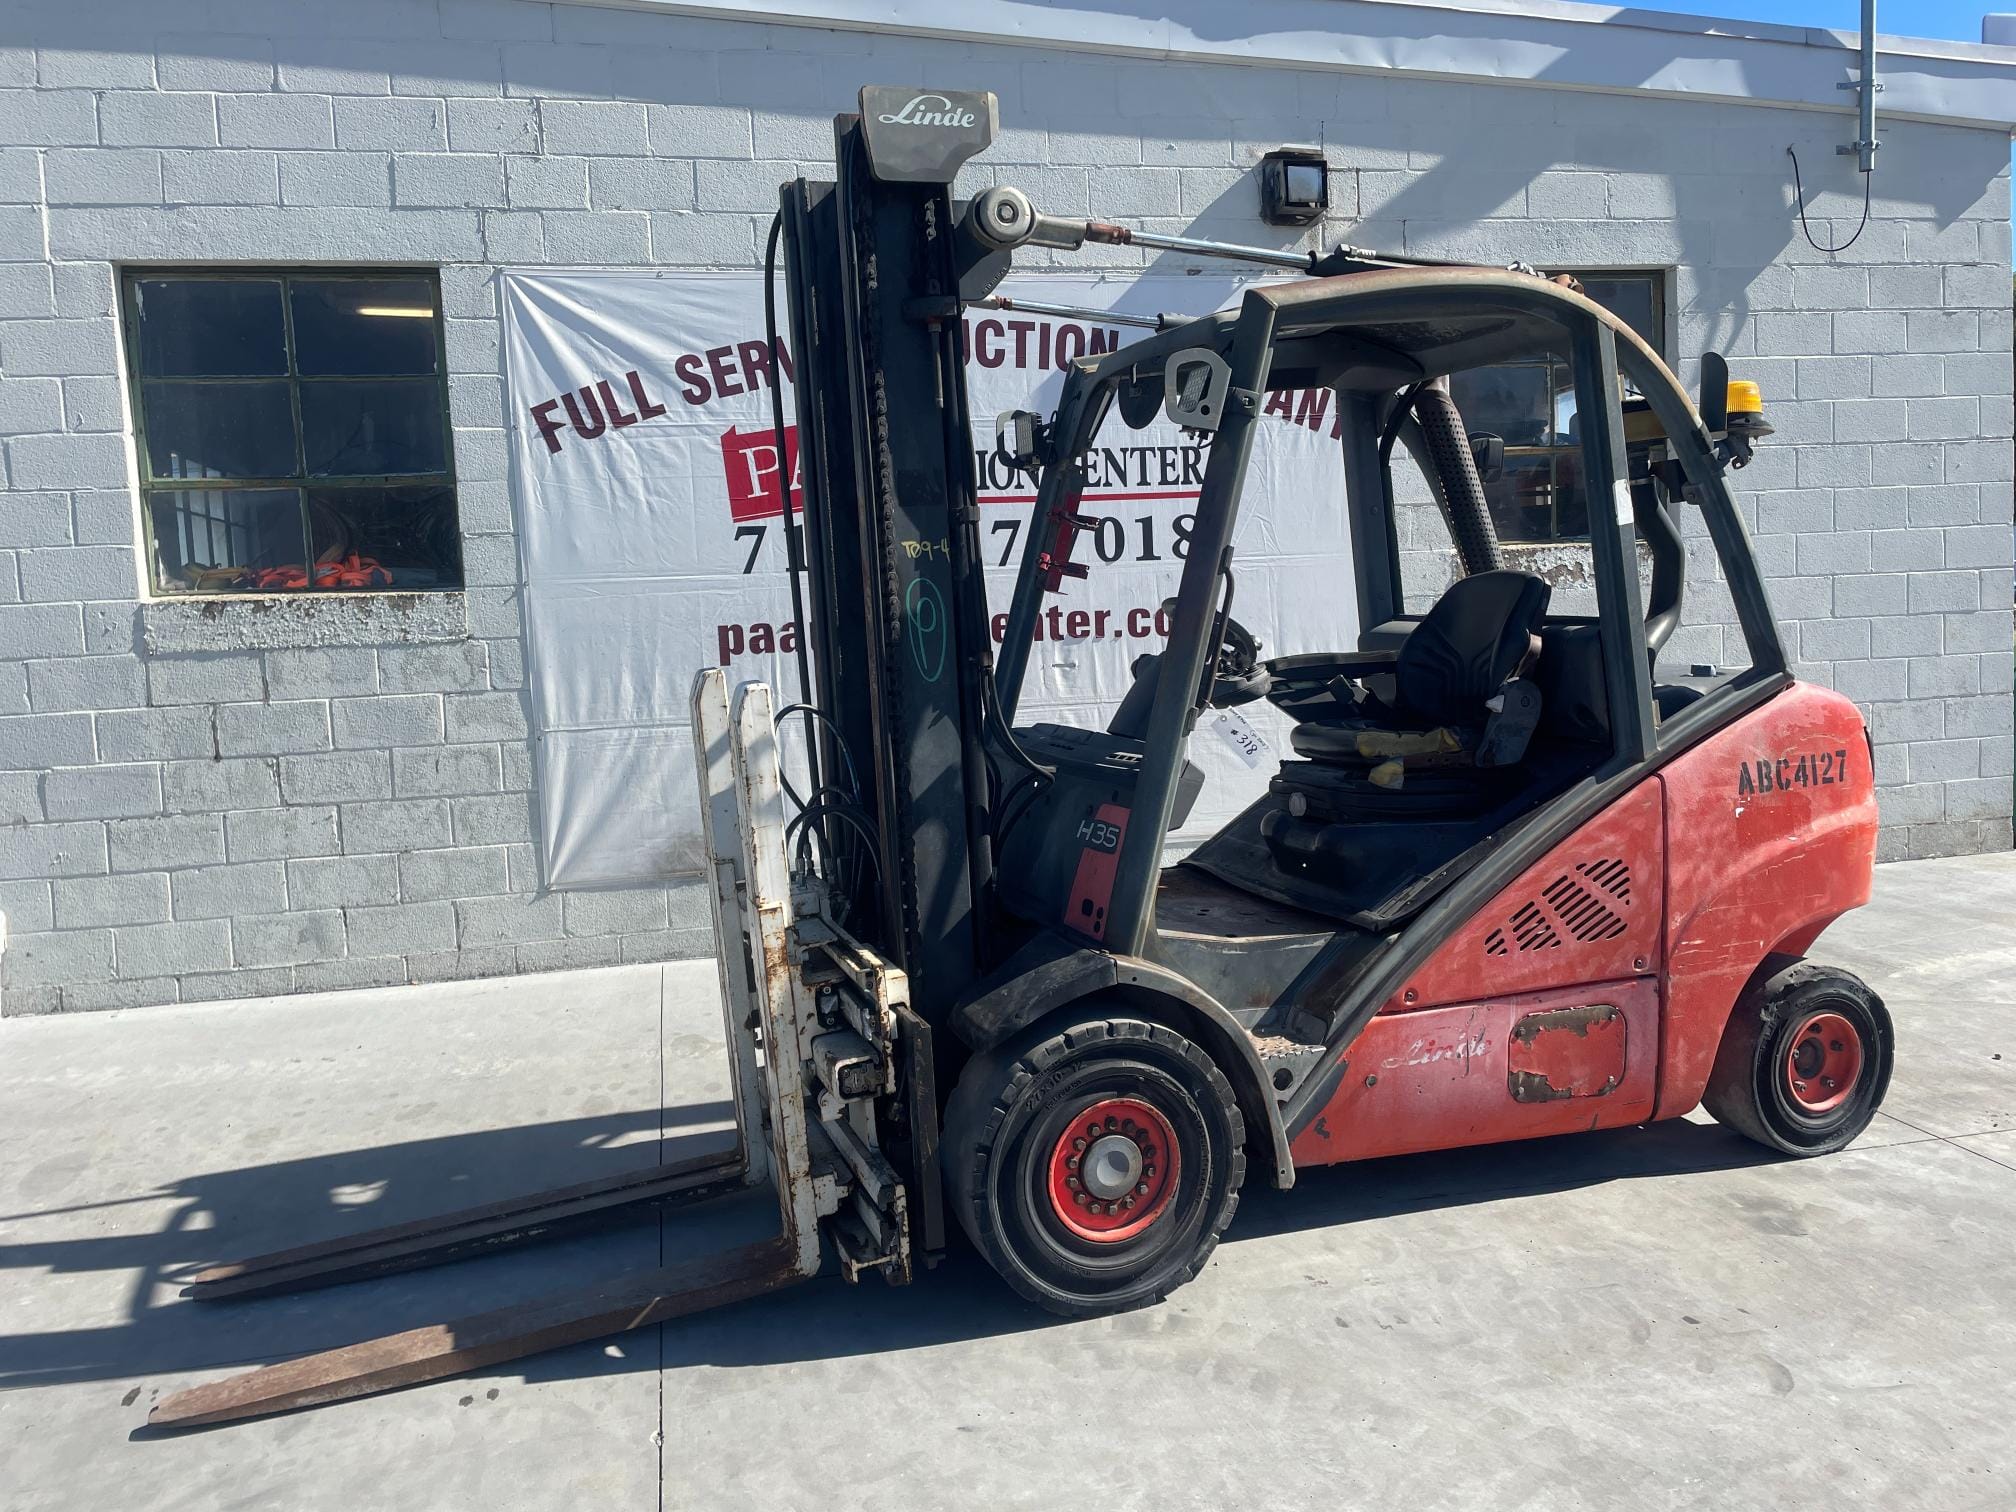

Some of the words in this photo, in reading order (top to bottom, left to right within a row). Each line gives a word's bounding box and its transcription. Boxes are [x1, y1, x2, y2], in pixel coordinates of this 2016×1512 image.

[878, 94, 976, 128] Linde
[530, 370, 667, 454] FULL
[1738, 749, 1847, 796] ABC4127
[1076, 819, 1120, 848] H35
